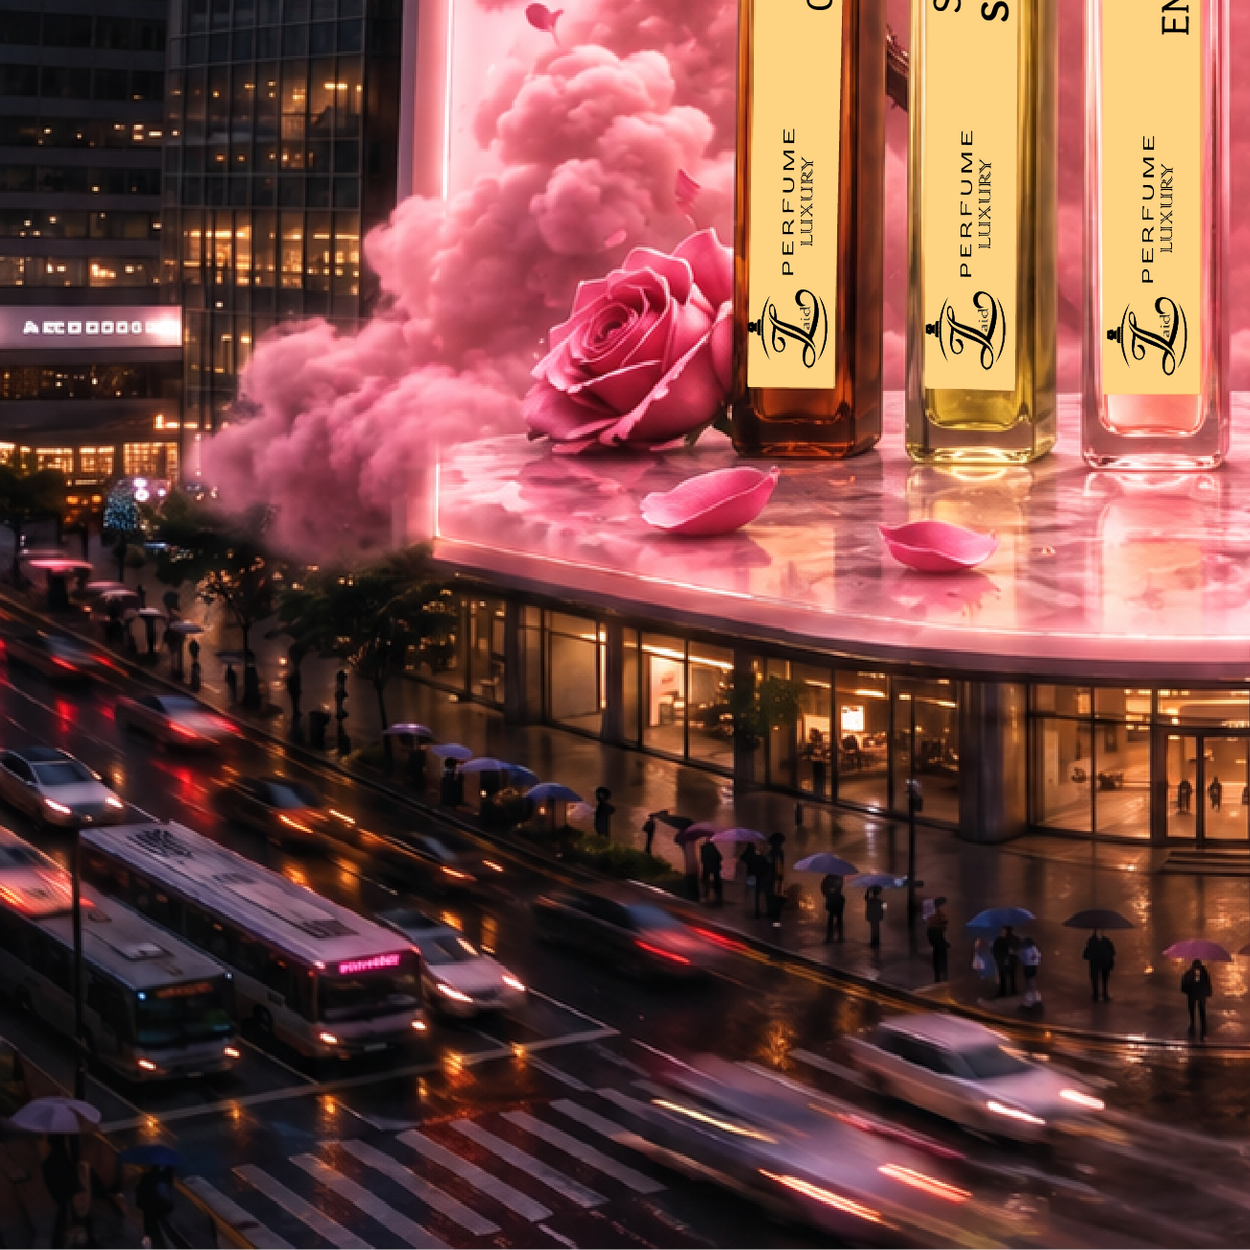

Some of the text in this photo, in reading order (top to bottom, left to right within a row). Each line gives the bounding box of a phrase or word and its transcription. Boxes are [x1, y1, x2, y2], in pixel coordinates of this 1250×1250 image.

[781, 128, 795, 276] PERFUME
[800, 156, 814, 247] LUXURY
[959, 130, 973, 278] PERFUME
[978, 159, 992, 249] LUXURY
[1141, 135, 1155, 284] PERFUME
[1159, 163, 1174, 253] LUXURY
